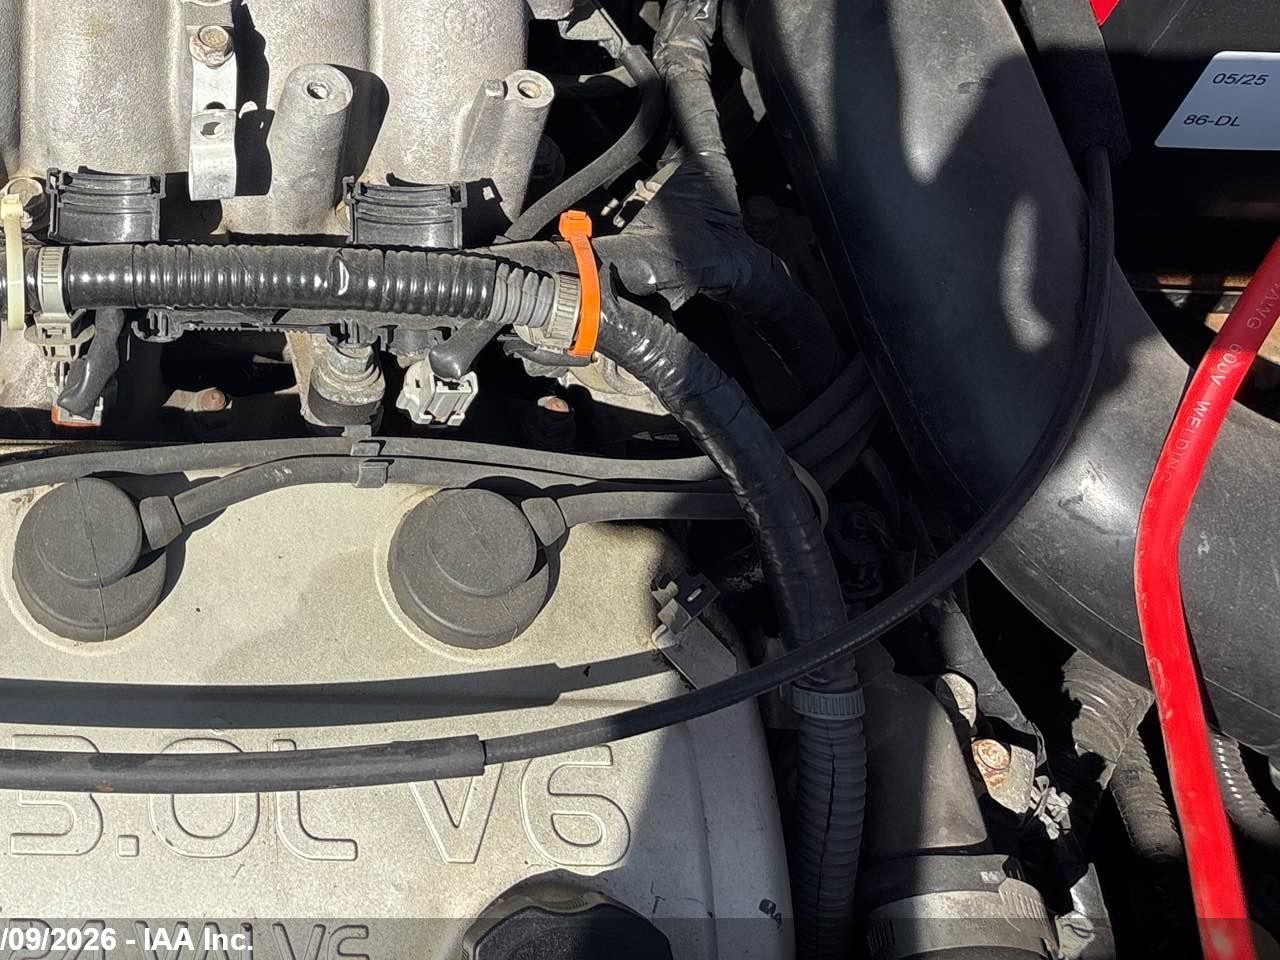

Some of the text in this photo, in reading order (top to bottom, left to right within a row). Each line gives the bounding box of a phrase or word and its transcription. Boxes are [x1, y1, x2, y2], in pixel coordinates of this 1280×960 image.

[1212, 73, 1269, 86] 05/25
[1183, 114, 1241, 127] 86-DL
[408, 743, 632, 867] V6
